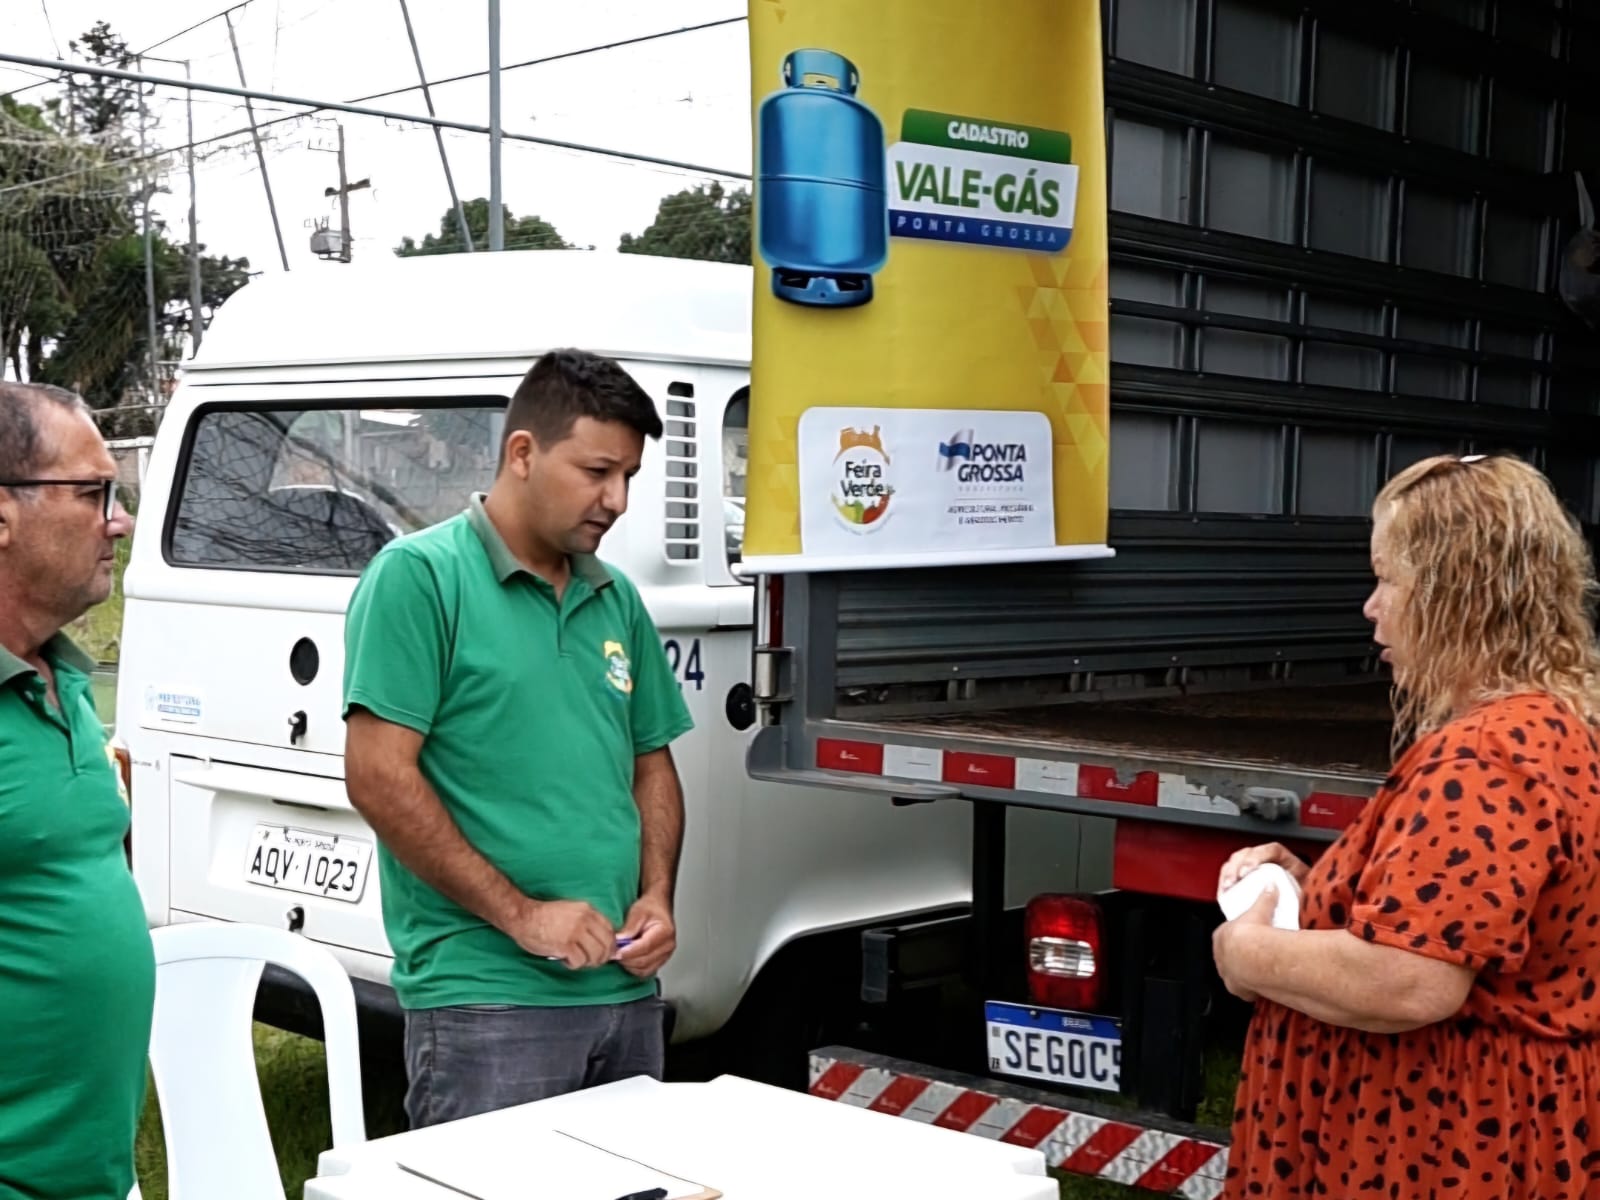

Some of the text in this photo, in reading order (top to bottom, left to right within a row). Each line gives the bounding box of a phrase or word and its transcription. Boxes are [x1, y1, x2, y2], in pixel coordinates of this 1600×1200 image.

[947, 121, 1029, 148] CADASTRO
[896, 161, 1060, 218] VALE-GÁS
[897, 216, 1057, 243] PONTA GROSSA
[972, 443, 1027, 462] PONTA
[845, 459, 882, 479] Feira
[957, 463, 1025, 482] GROSSA
[840, 479, 884, 498] Verde
